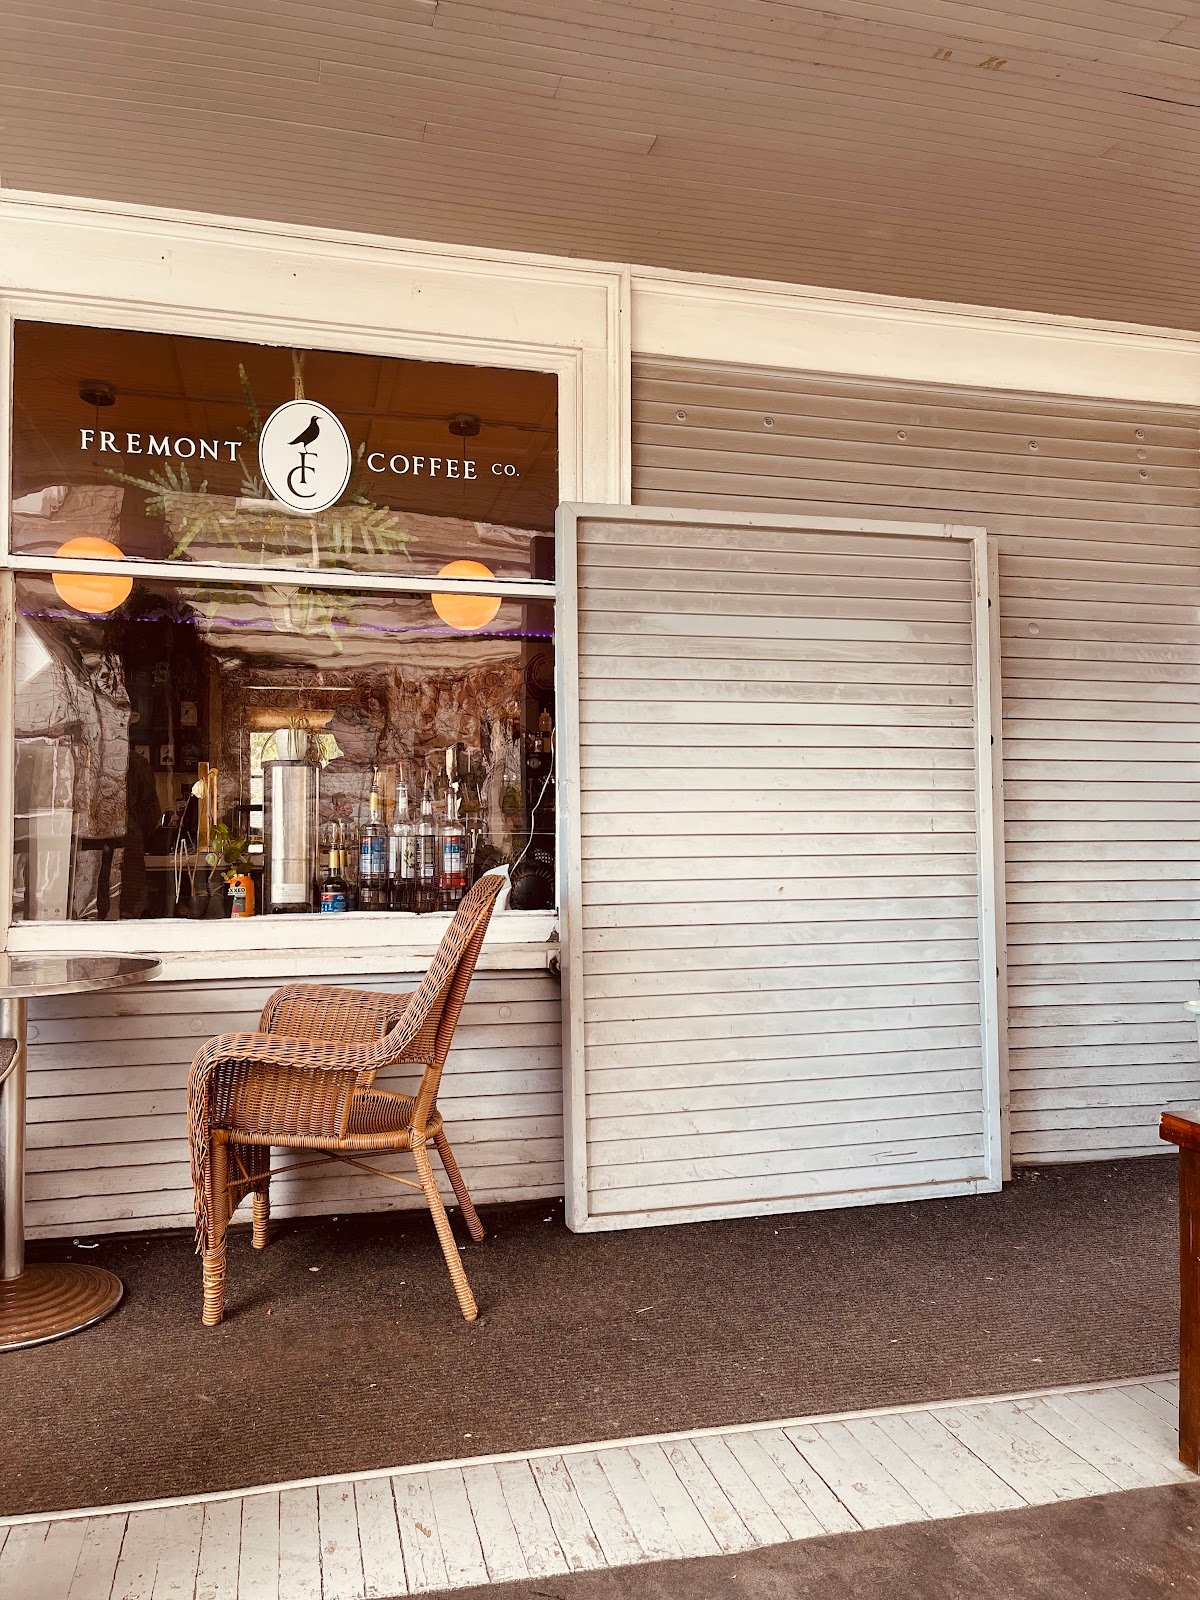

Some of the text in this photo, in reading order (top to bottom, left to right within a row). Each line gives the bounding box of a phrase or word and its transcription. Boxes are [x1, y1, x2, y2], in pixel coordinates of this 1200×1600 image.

[79, 428, 520, 480] FREMONT COFFEE CO.
